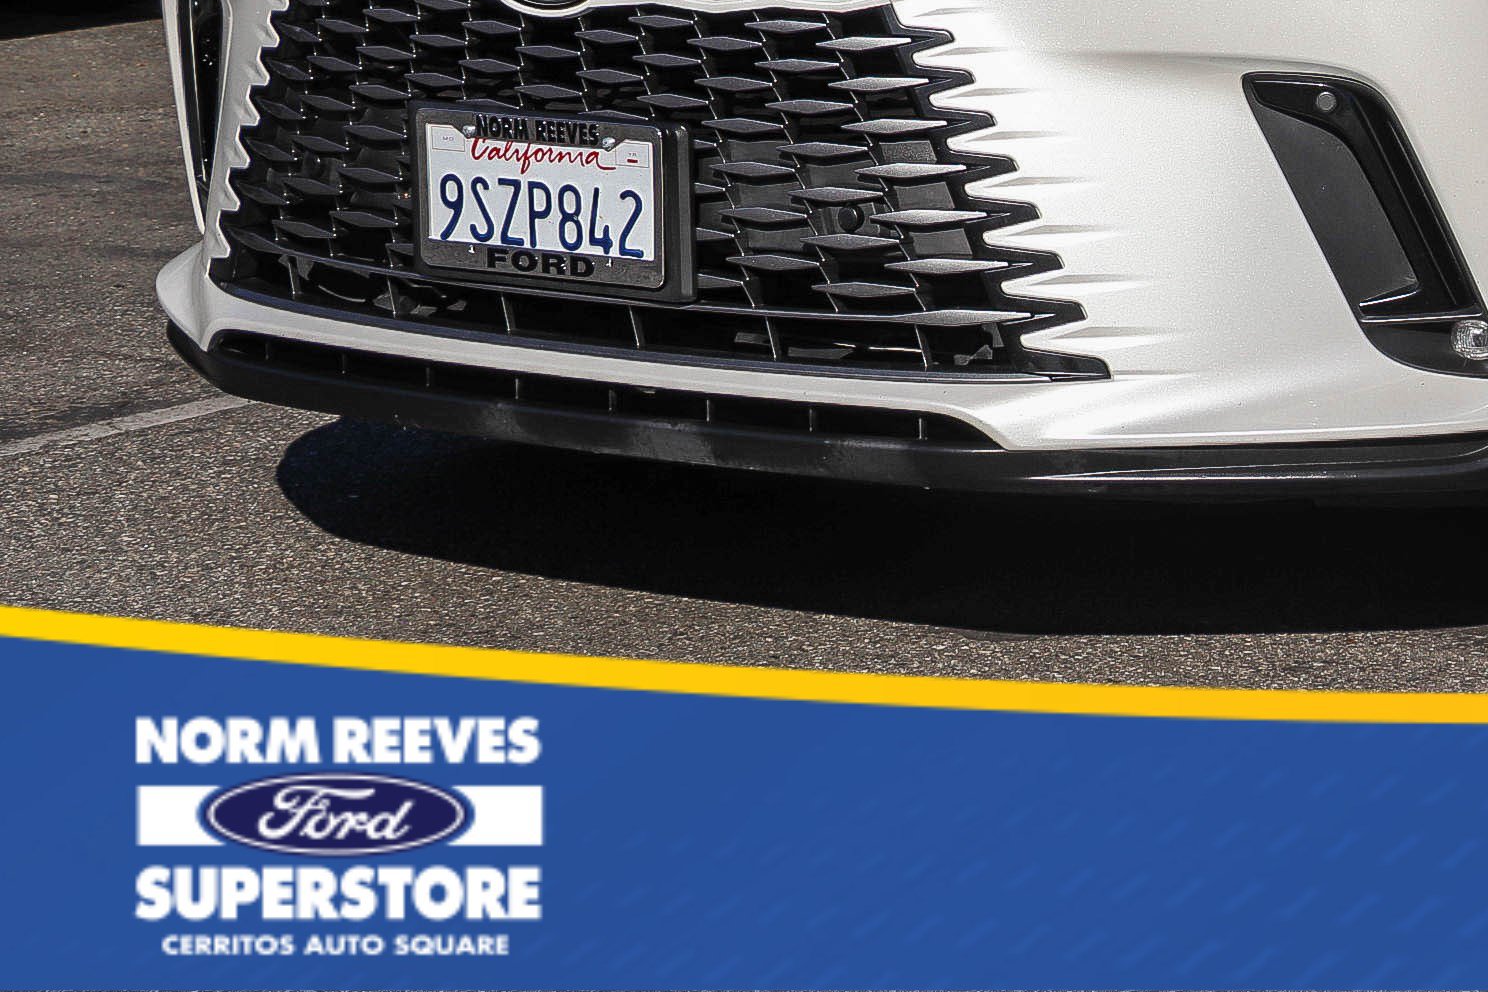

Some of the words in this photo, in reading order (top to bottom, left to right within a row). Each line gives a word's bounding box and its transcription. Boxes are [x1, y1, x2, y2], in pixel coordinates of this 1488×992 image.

[473, 112, 529, 140] NORM
[535, 118, 600, 146] REEVES
[470, 137, 617, 175] California
[440, 173, 645, 258] 9SZP842
[486, 247, 595, 277] FORD
